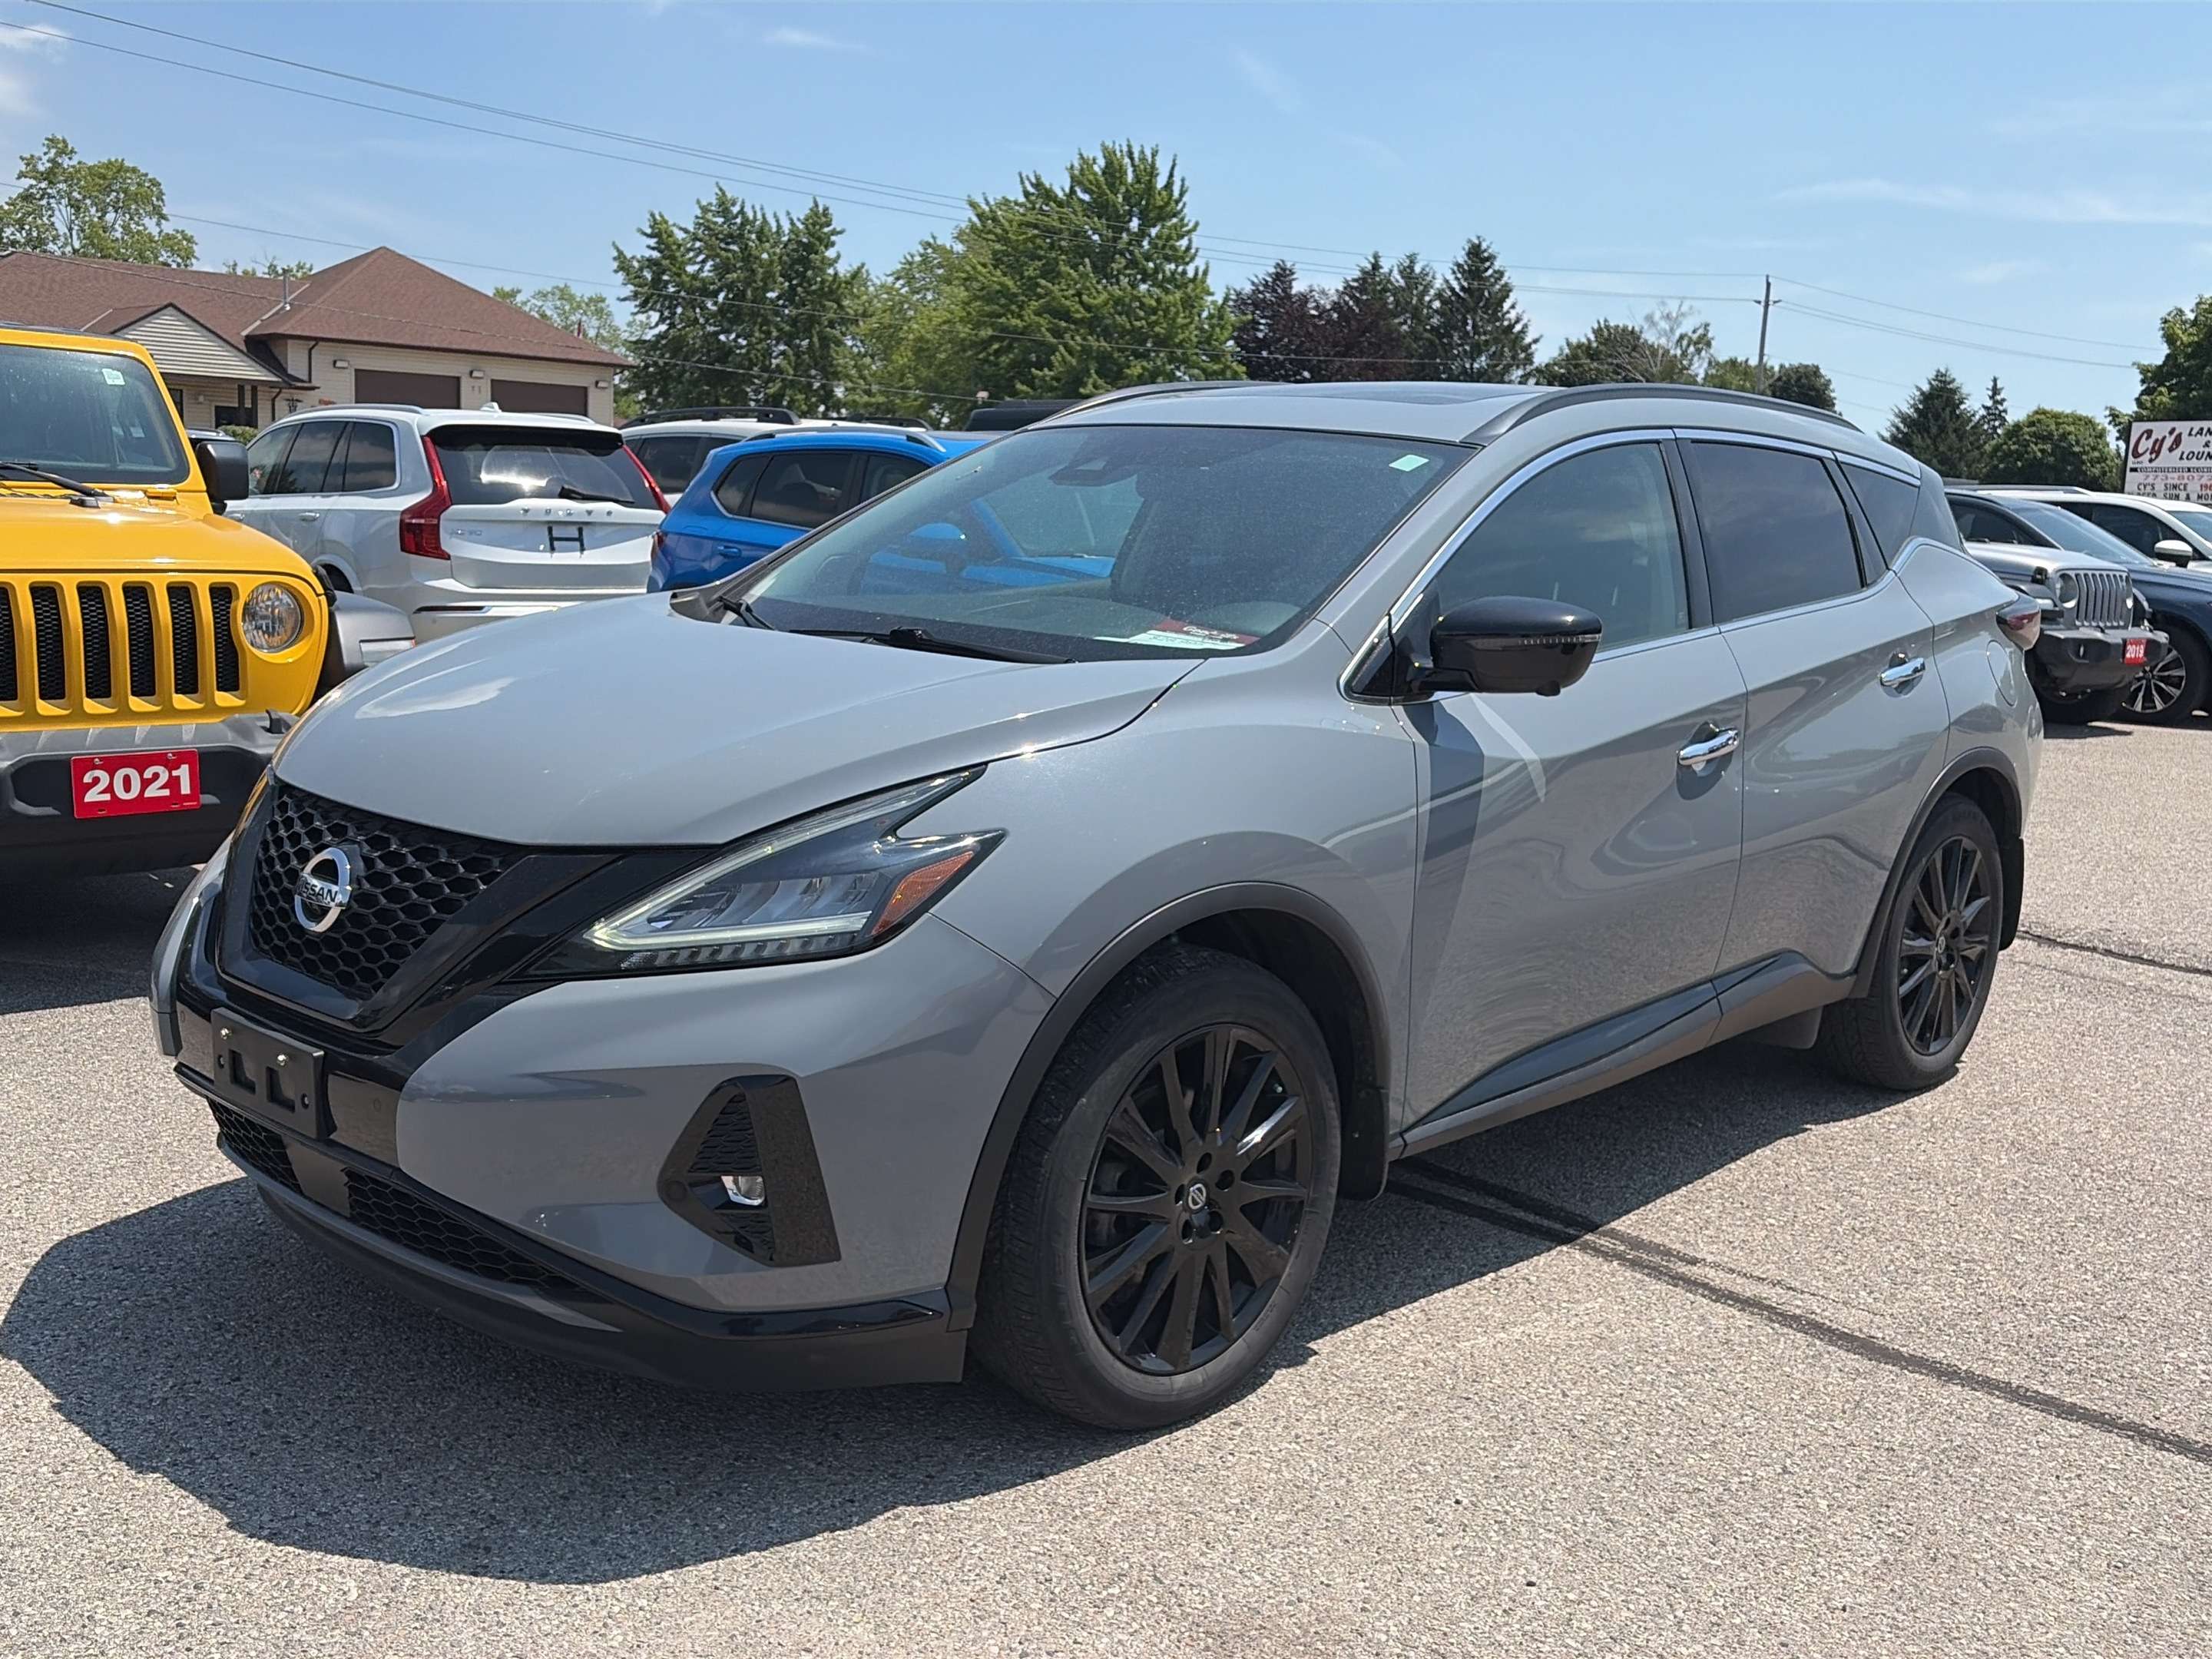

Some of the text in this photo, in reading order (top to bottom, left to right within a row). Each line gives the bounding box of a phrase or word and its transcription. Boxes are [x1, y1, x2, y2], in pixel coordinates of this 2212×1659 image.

[2131, 426, 2182, 463] Cy's
[2179, 450, 2212, 461] LOUN
[2164, 482, 2188, 492] SINCE
[83, 764, 190, 803] 2021
[296, 879, 338, 902] NISSAN
